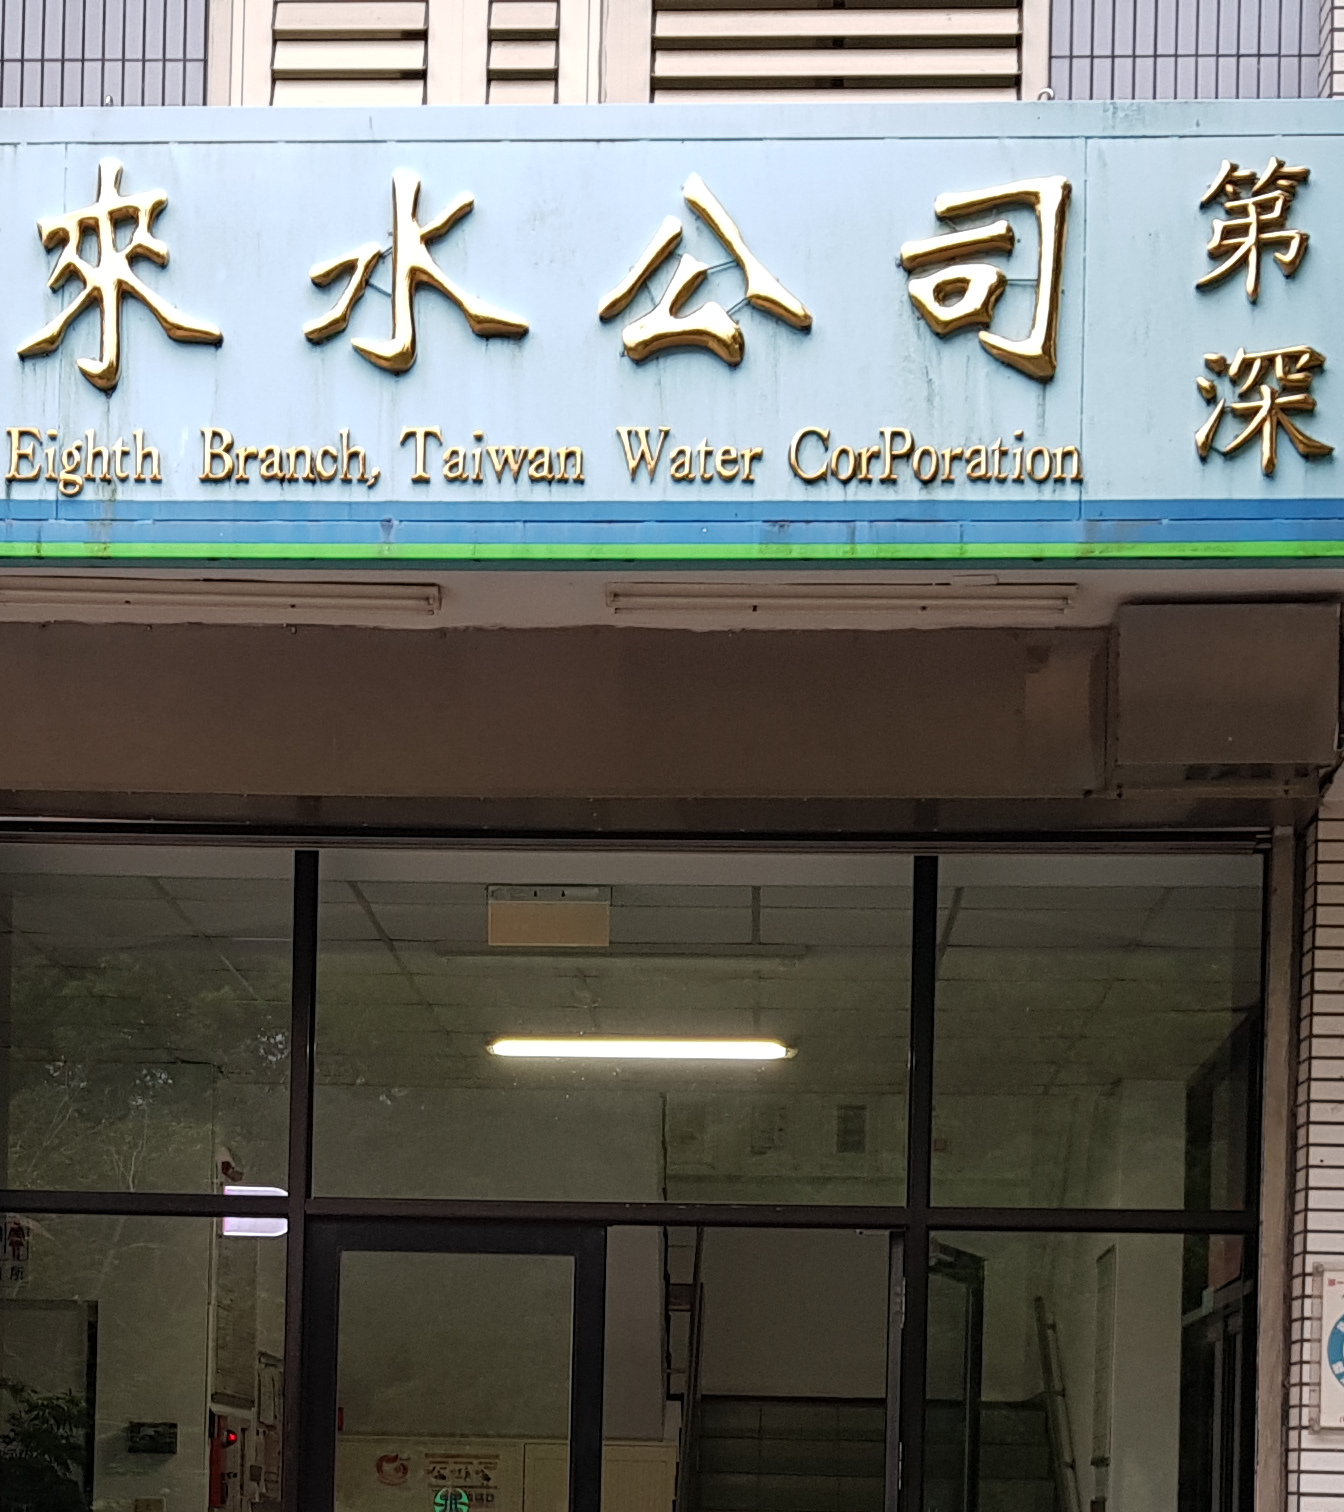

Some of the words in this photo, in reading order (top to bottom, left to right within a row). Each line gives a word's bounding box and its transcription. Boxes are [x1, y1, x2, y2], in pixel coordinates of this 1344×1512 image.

[5, 427, 163, 496] Eighth
[199, 427, 381, 488] Branch,
[399, 426, 585, 484] Taiwan
[616, 426, 764, 484] Water
[789, 427, 1084, 485] CorPoration
